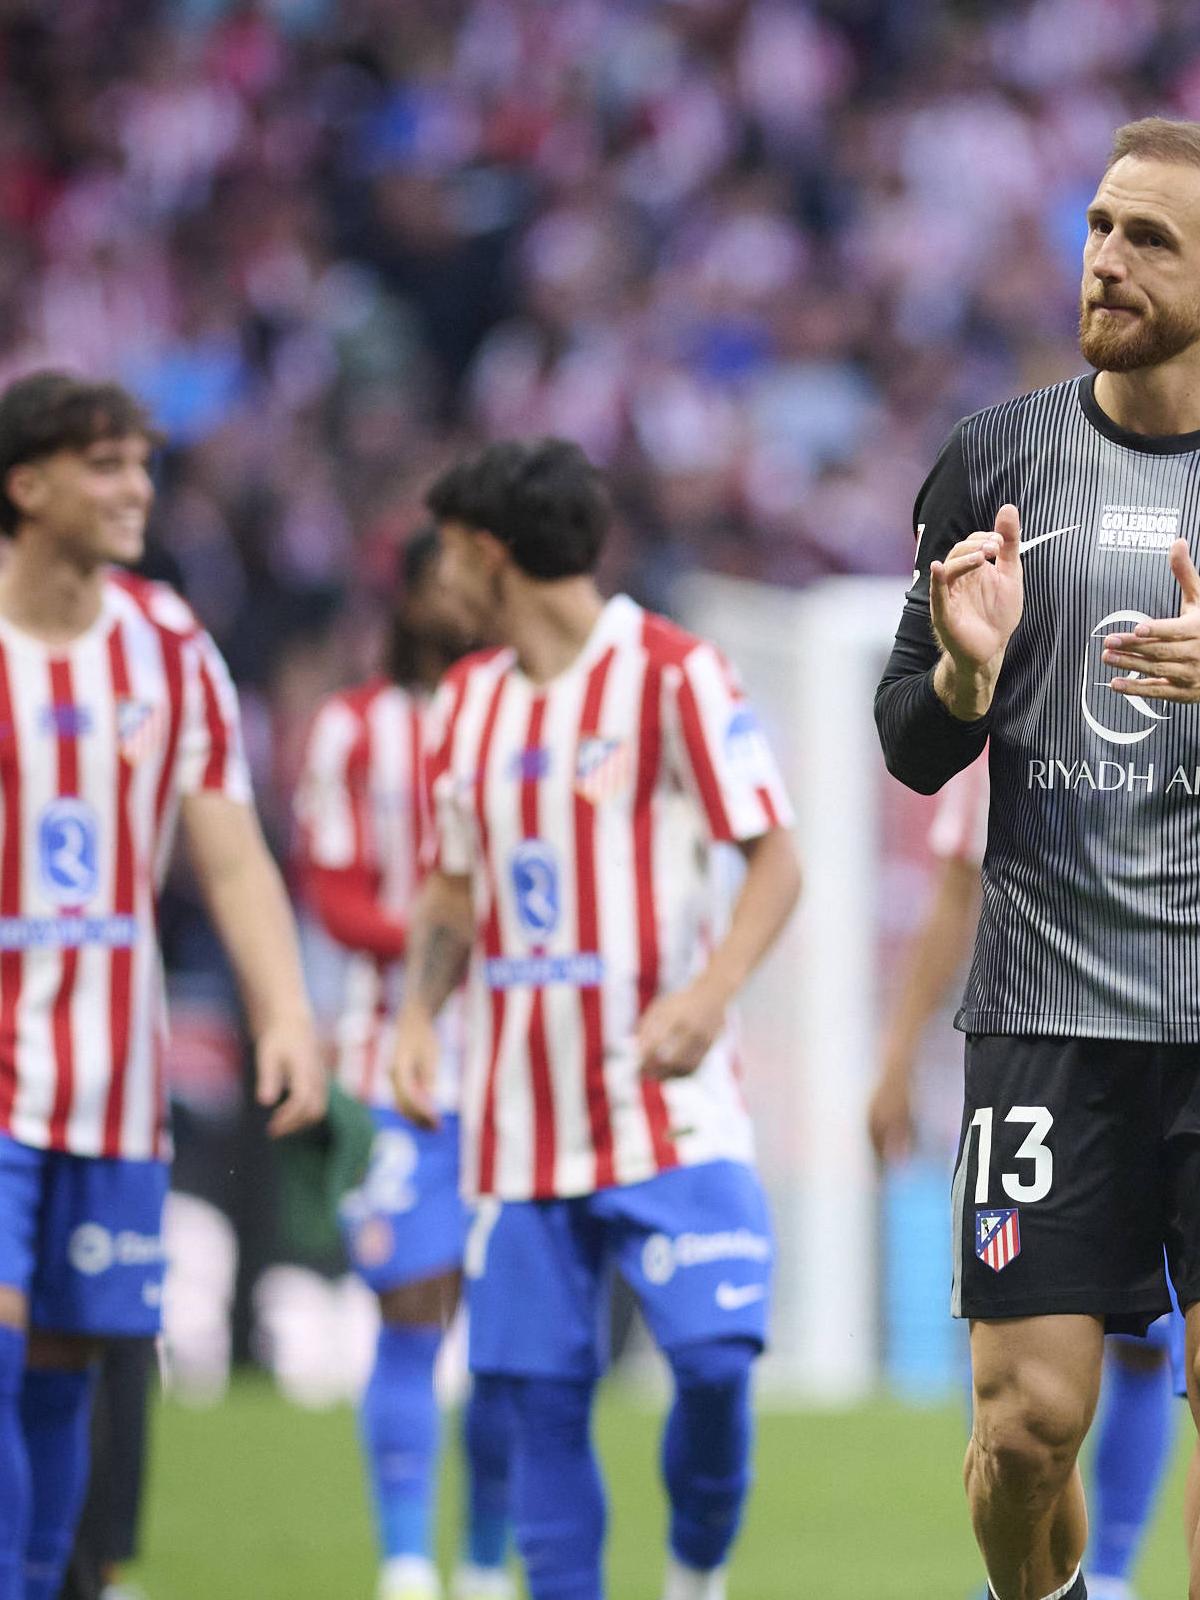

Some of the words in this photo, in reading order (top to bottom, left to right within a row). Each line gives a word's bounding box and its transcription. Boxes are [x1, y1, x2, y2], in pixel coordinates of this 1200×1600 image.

[1101, 512, 1178, 533] GOLEADOR
[1098, 529, 1116, 545] DE
[1028, 759, 1154, 793] RIYADH
[971, 1105, 1054, 1203] 13
